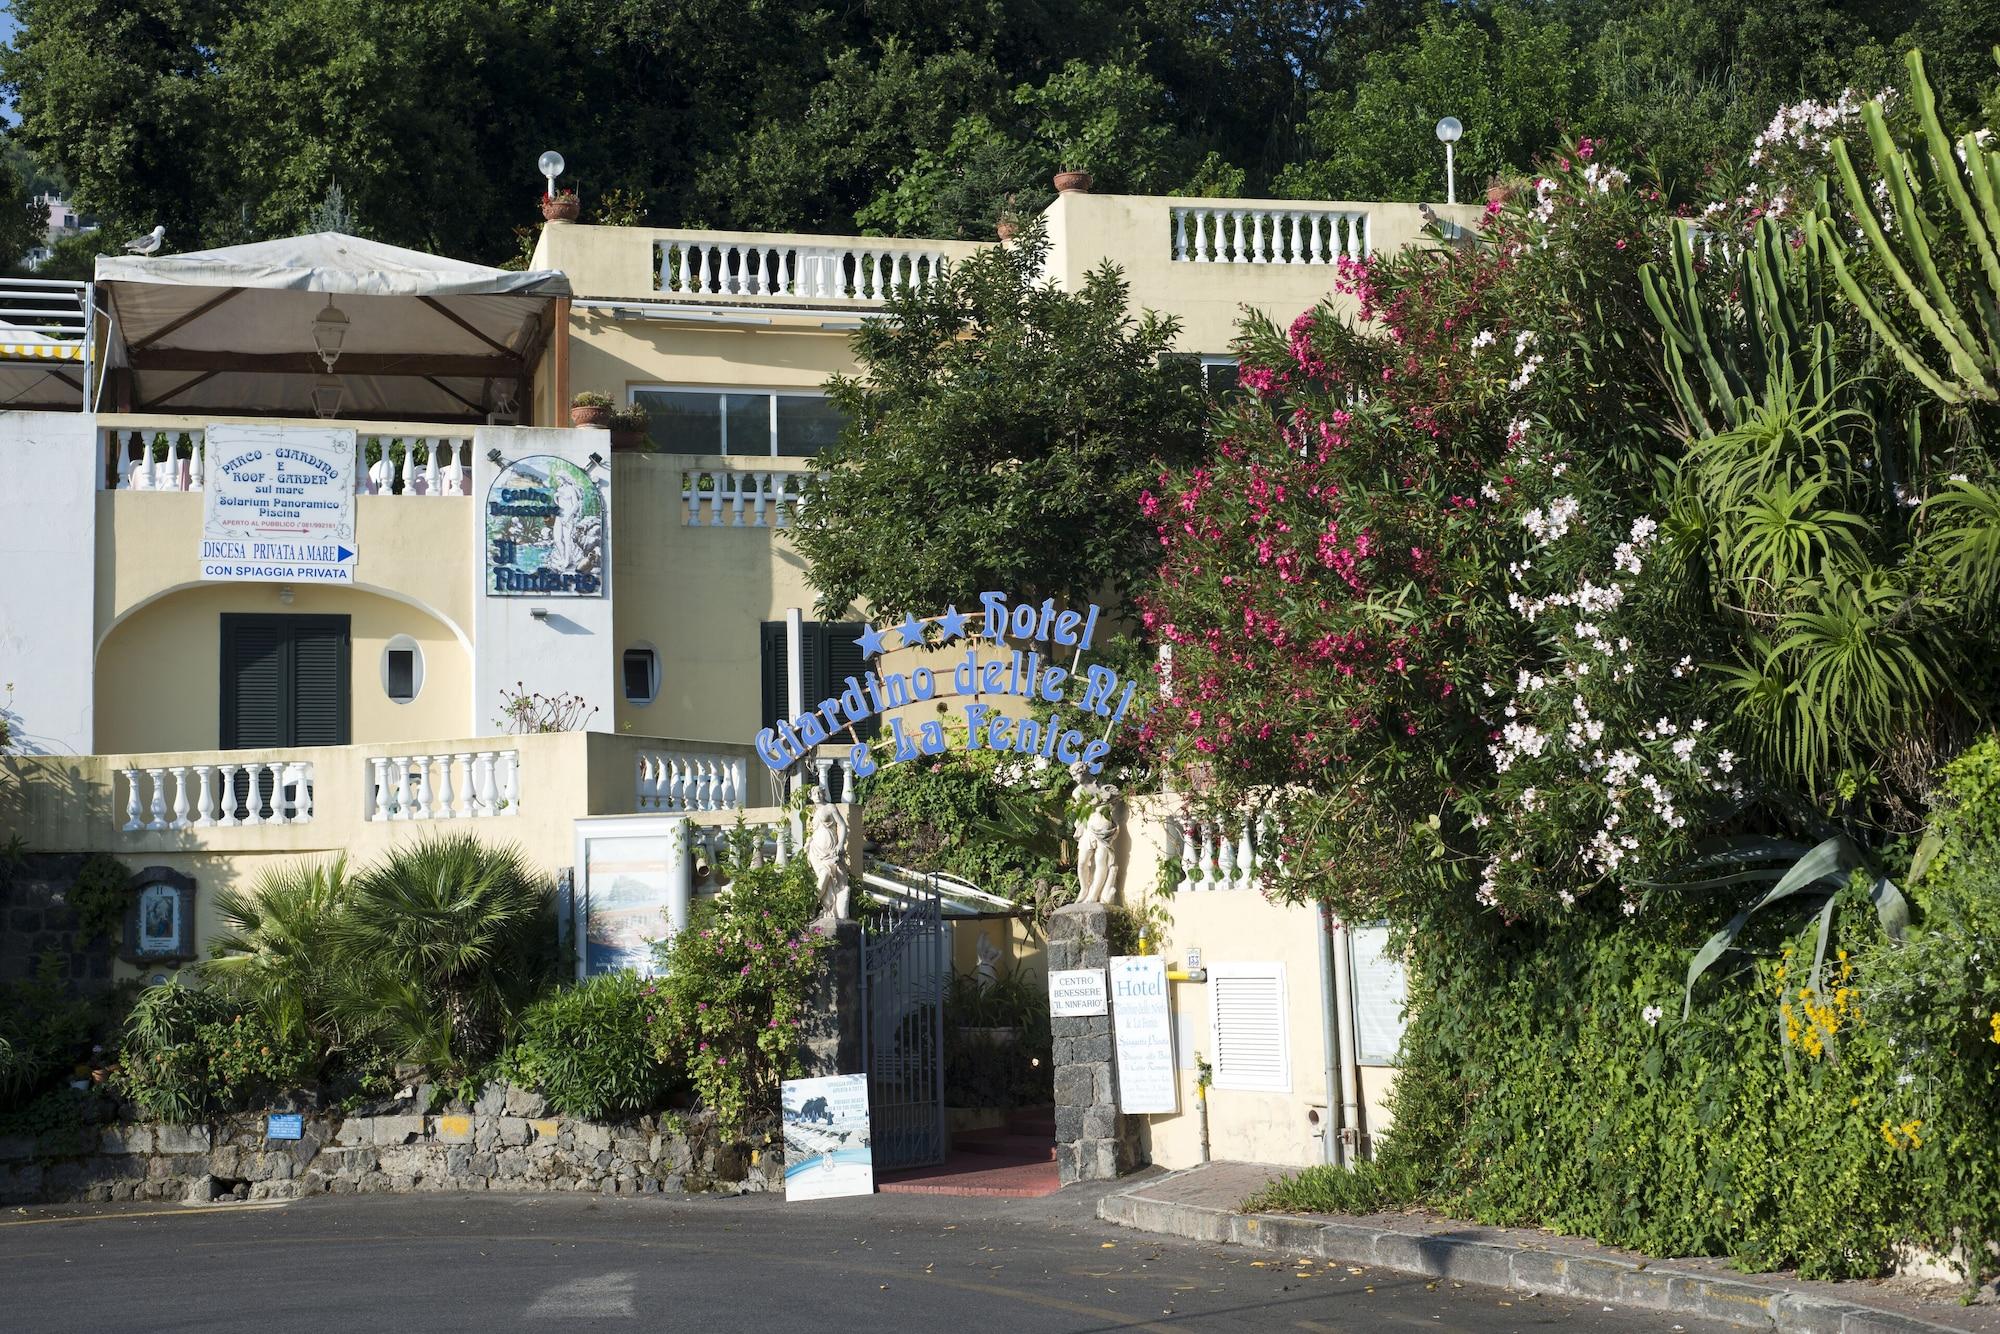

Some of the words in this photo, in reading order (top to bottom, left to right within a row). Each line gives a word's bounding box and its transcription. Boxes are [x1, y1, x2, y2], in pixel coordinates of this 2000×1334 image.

[221, 449, 263, 475] PARCO
[277, 462, 285, 471] E
[233, 472, 266, 483] ROOF
[277, 474, 328, 485] GARDEN
[255, 485, 272, 494] sul
[275, 487, 304, 495] mare
[219, 496, 270, 507] Solarium
[273, 498, 340, 509] Panoramico
[259, 508, 301, 518] Piscina
[204, 542, 246, 559] DISCESA
[253, 543, 295, 560] PRIVATA
[297, 545, 304, 560] A
[306, 545, 336, 561] MARE
[205, 565, 232, 576] CON
[235, 566, 294, 577] SPIAGGIA
[297, 567, 347, 578] PRIVATA
[979, 591, 1100, 651] Hotel
[755, 666, 936, 771] Giardino
[954, 650, 1068, 702] delle
[849, 739, 878, 778] e
[889, 717, 947, 762] La
[964, 703, 1111, 775] Fenice
[1059, 977, 1094, 986] CENTRO
[1117, 971, 1162, 997] Hotel
[1054, 988, 1101, 998] BENESSERE
